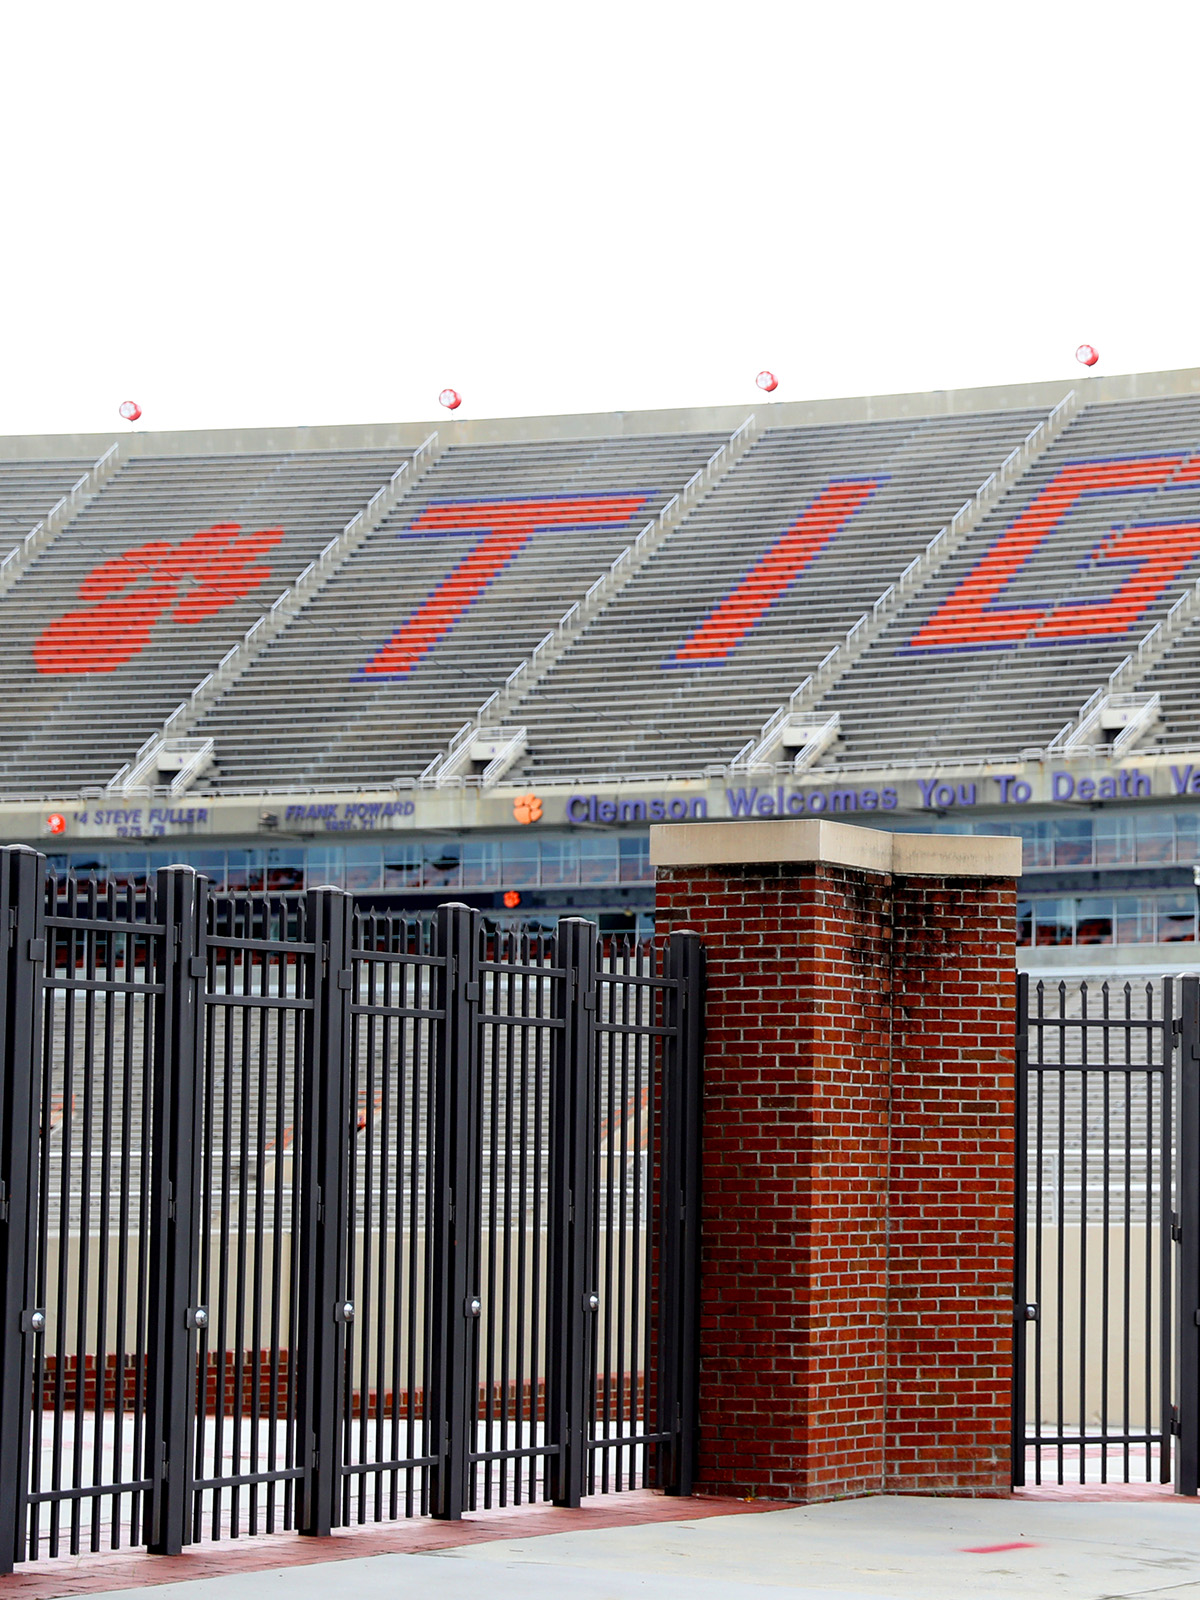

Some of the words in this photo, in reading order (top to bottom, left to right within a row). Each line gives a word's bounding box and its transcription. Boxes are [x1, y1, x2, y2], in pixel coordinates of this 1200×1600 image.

[566, 795, 708, 823] Clemson
[726, 786, 898, 817] Welcomes
[917, 778, 976, 807] You
[994, 775, 1032, 804] To
[1052, 768, 1150, 801] Death
[94, 808, 142, 825] STEVE
[148, 808, 208, 823] FULLER
[285, 805, 338, 820] FRANK
[345, 801, 415, 818] HOWARD
